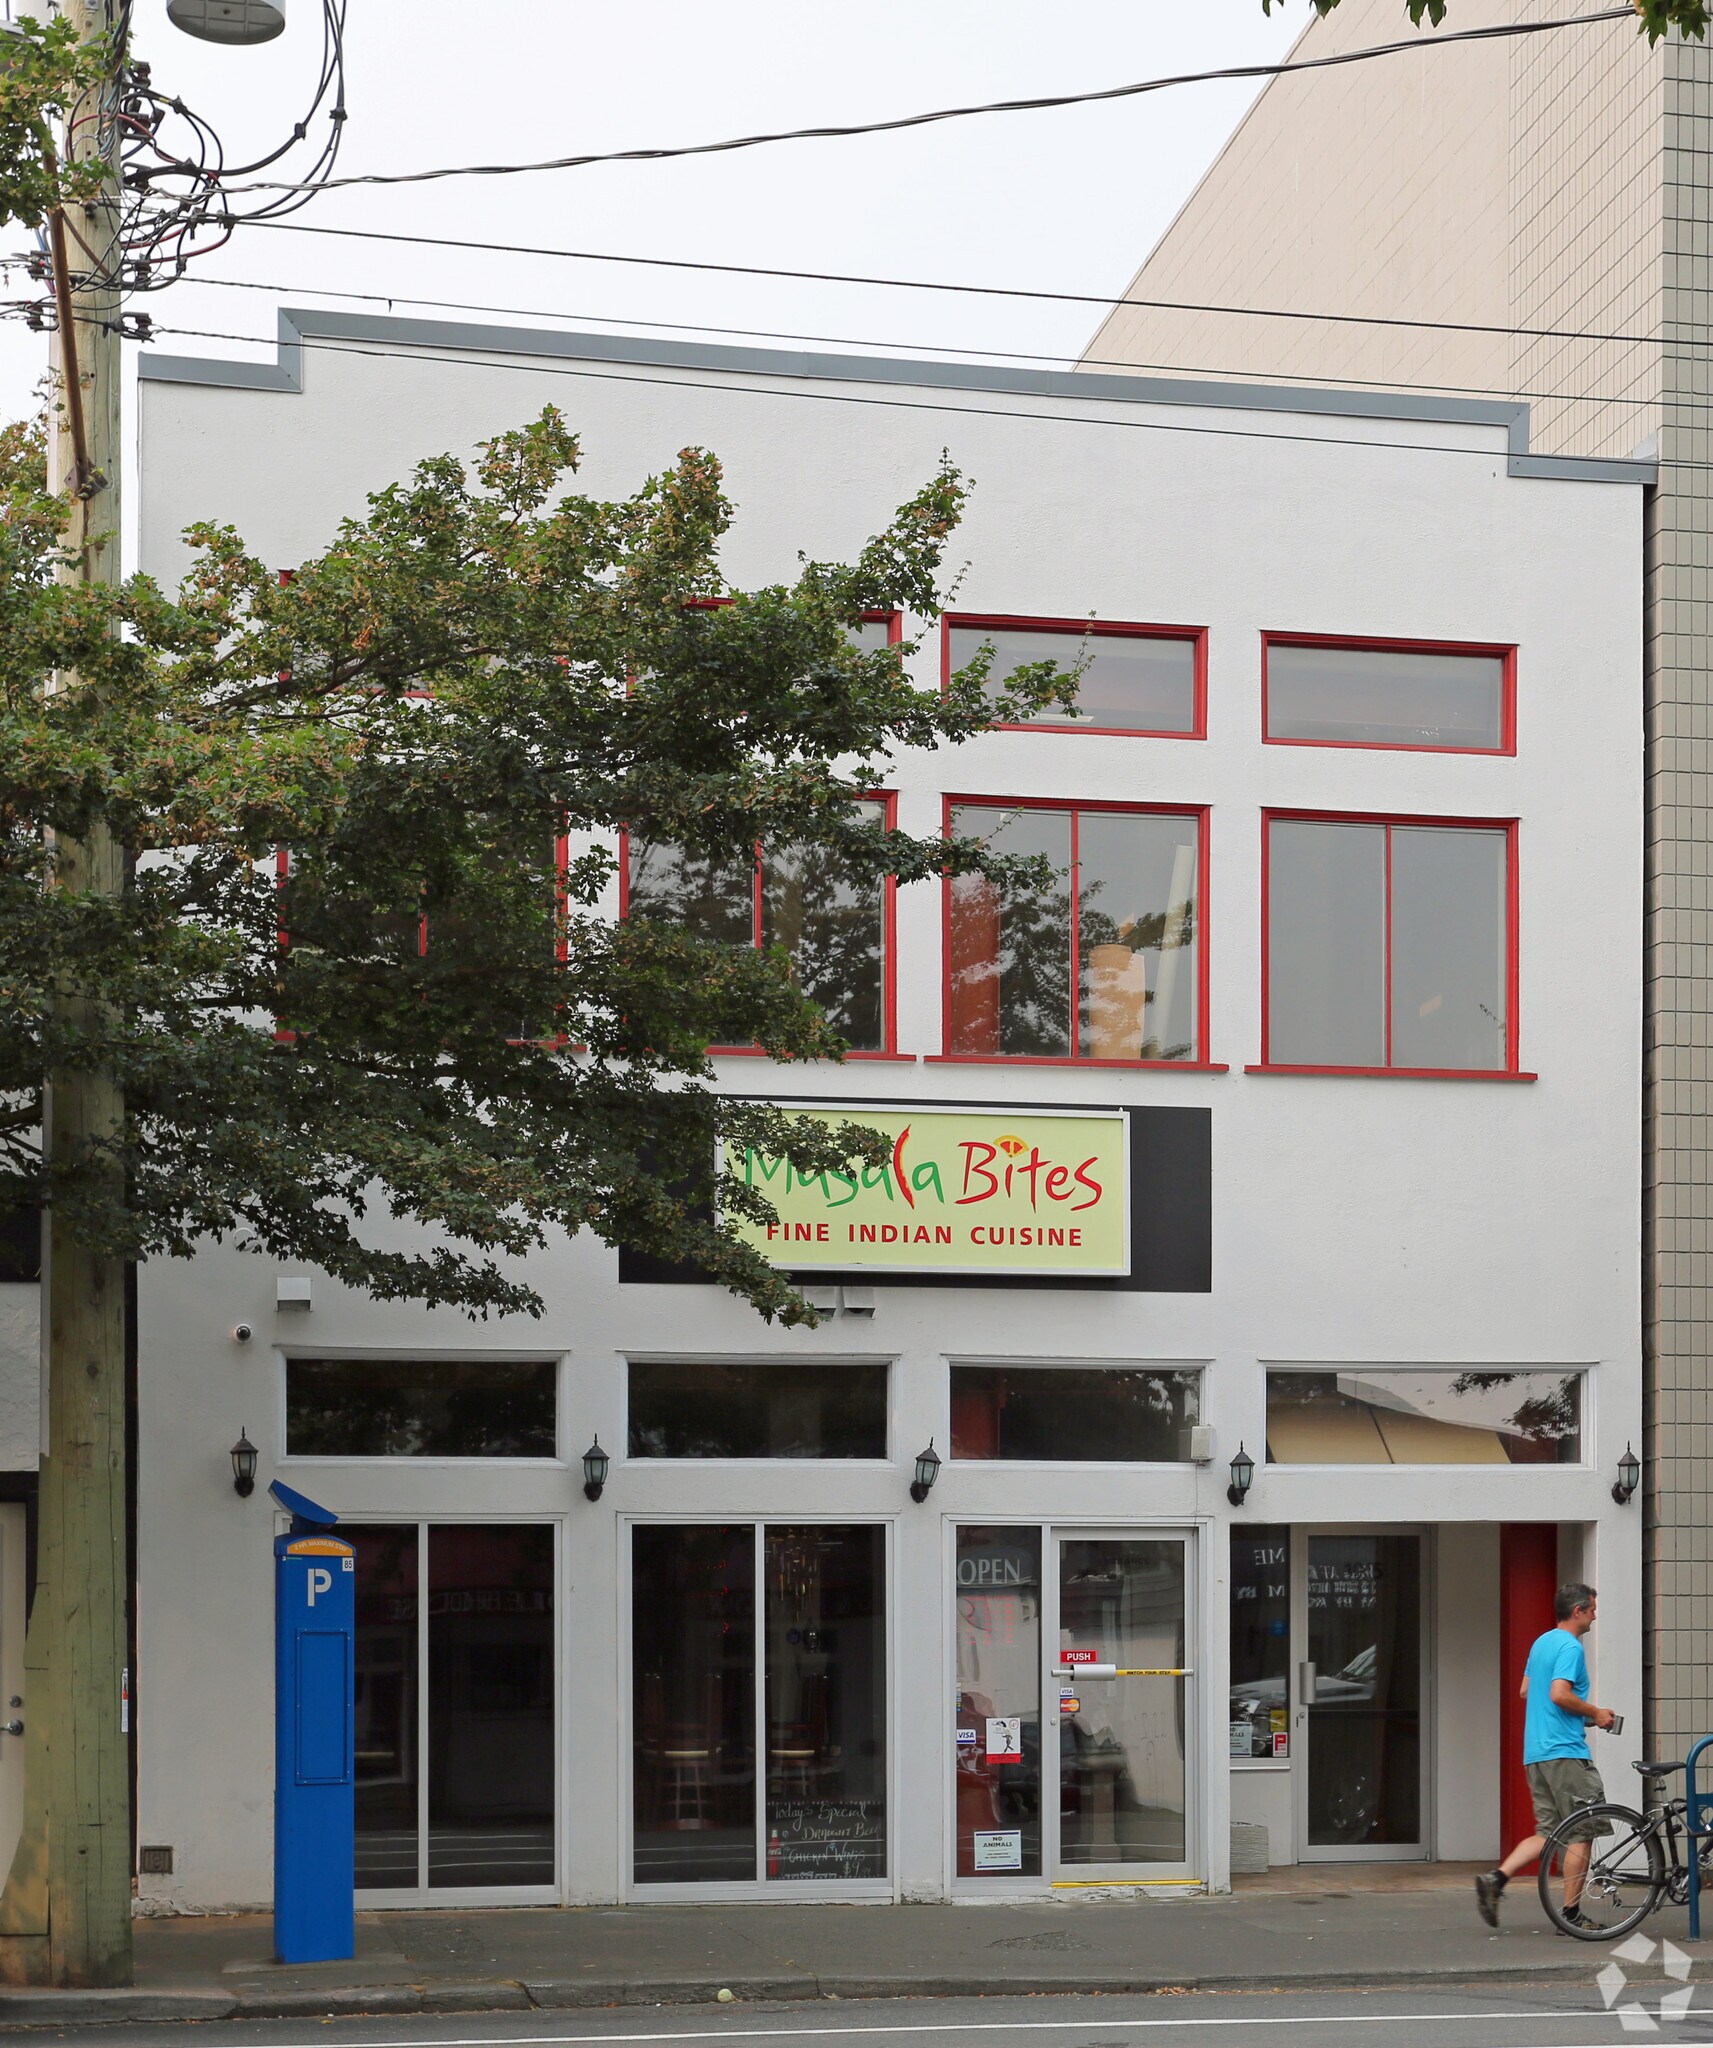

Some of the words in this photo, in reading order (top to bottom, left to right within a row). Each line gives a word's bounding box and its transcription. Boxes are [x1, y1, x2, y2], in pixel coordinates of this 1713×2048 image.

[745, 1124, 945, 1209] Masala
[954, 1135, 1102, 1213] Bites
[767, 1222, 829, 1242] FINE
[849, 1223, 952, 1244] INDIAN
[970, 1226, 1082, 1246] CUISINE
[344, 1560, 352, 1569] 85
[957, 1559, 1020, 1585] OPEN
[307, 1568, 332, 1607] P
[1067, 1653, 1091, 1661] PUSH
[818, 1801, 868, 1824] Special
